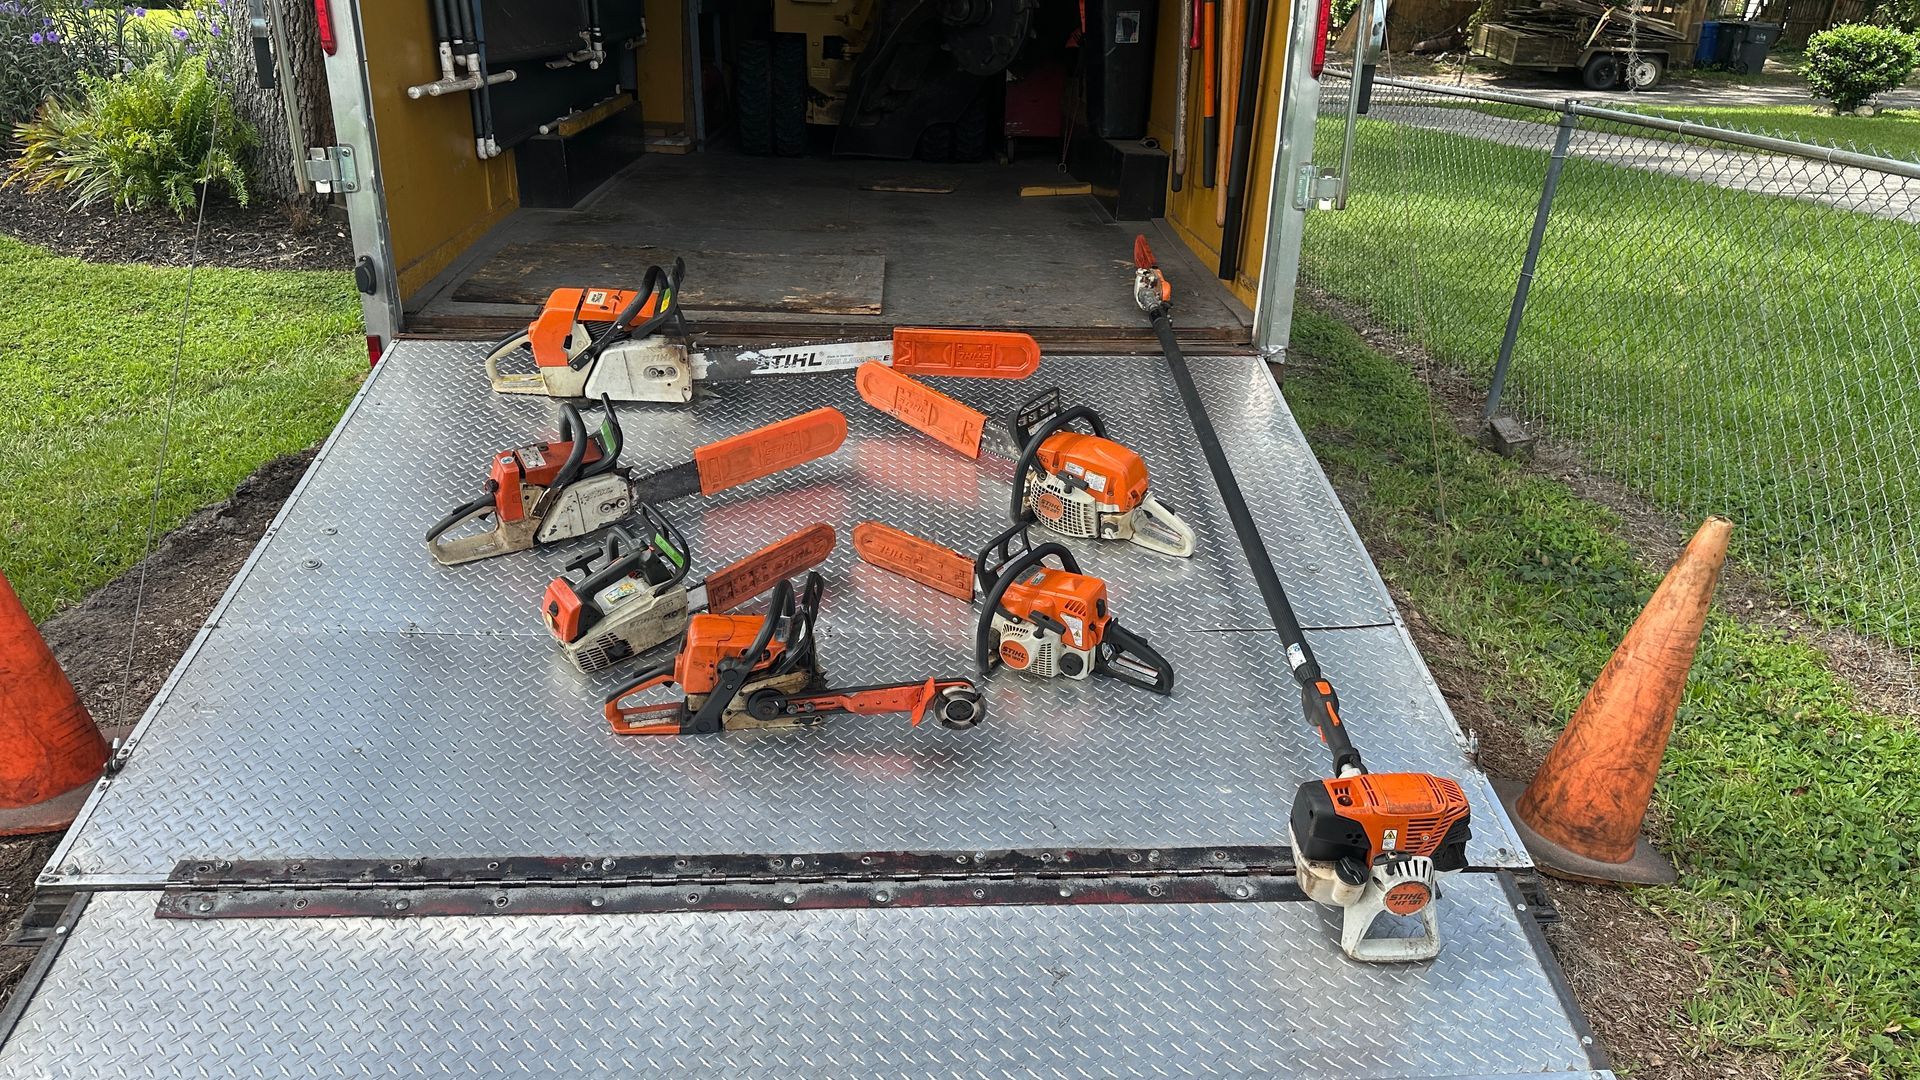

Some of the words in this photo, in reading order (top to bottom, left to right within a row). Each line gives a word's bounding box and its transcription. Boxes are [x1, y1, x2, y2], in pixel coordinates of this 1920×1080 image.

[1040, 498, 1061, 511] STIHL
[1001, 646, 1026, 659] STIHL
[1389, 893, 1426, 901] STIHL
